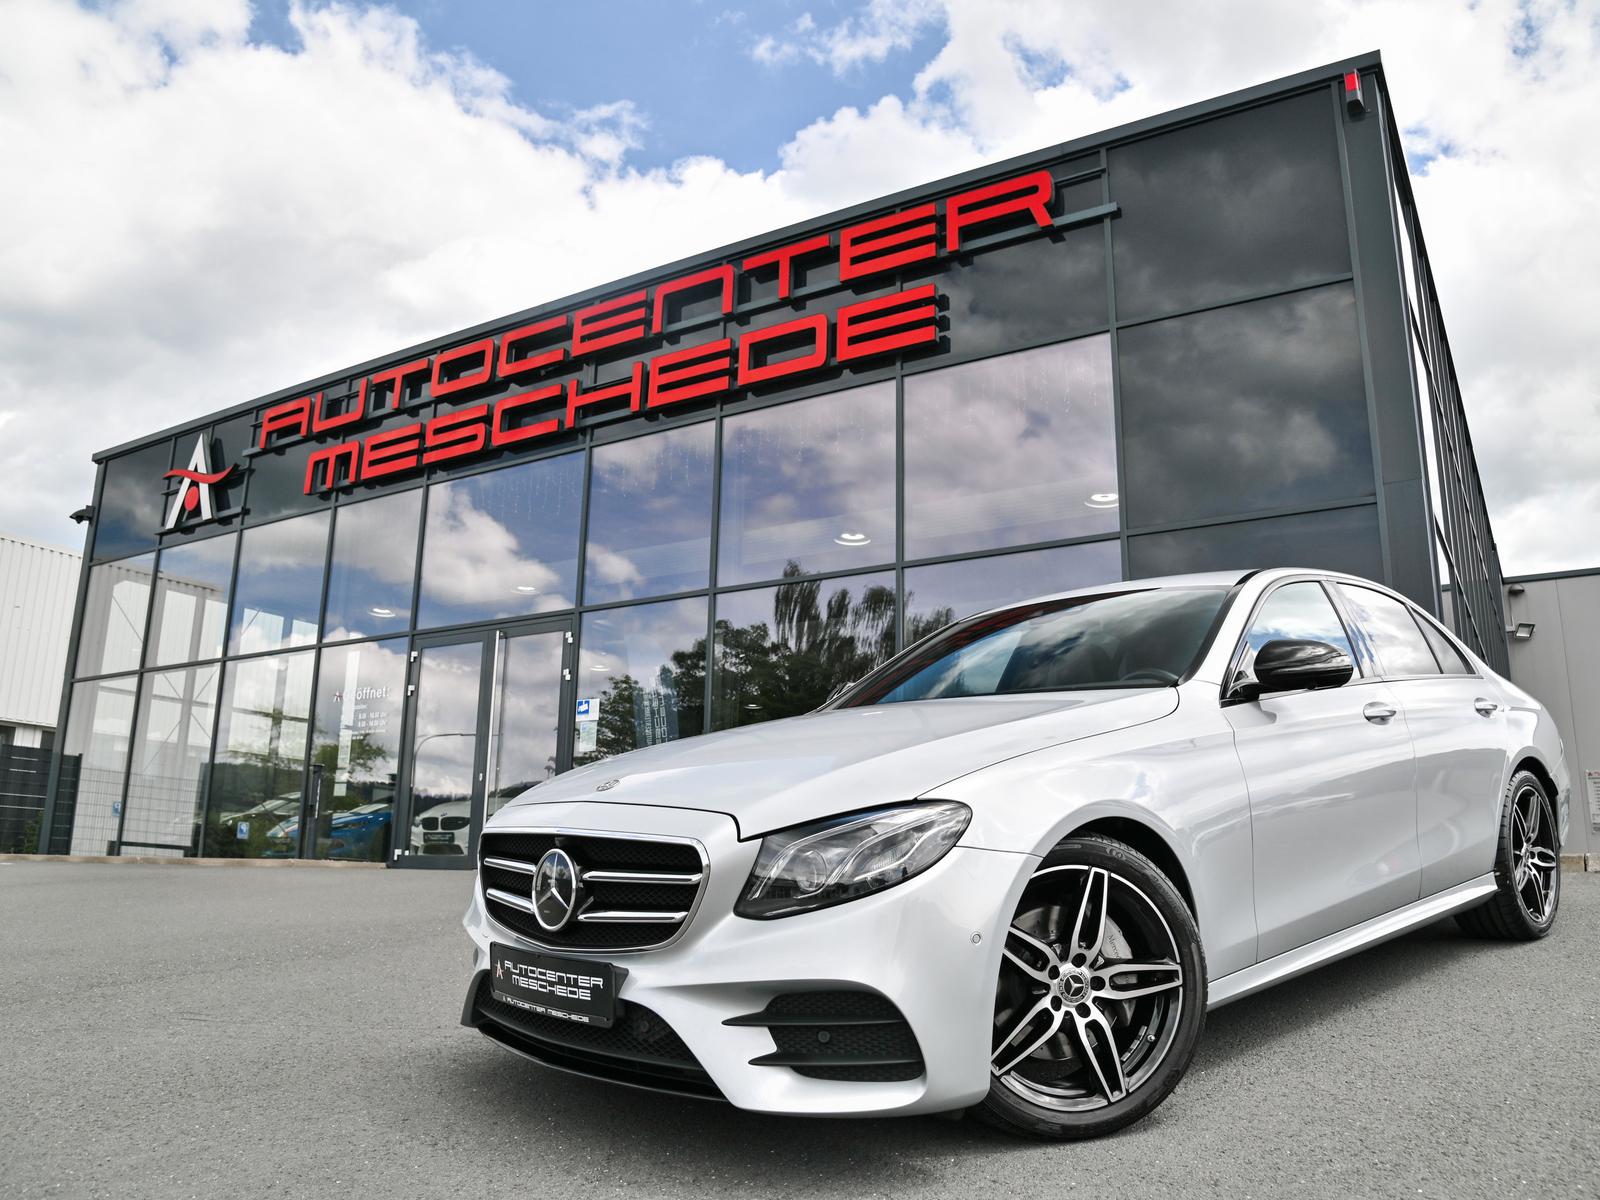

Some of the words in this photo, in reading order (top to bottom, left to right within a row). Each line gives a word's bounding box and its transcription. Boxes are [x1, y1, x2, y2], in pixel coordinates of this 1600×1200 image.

[259, 169, 1055, 449] AUTOCENTER
[303, 283, 937, 495] MESCHEDE
[504, 960, 603, 989] AUTOCENTER
[511, 974, 592, 1001] MESCHEDE
[506, 997, 546, 1013] AUTOCENTER
